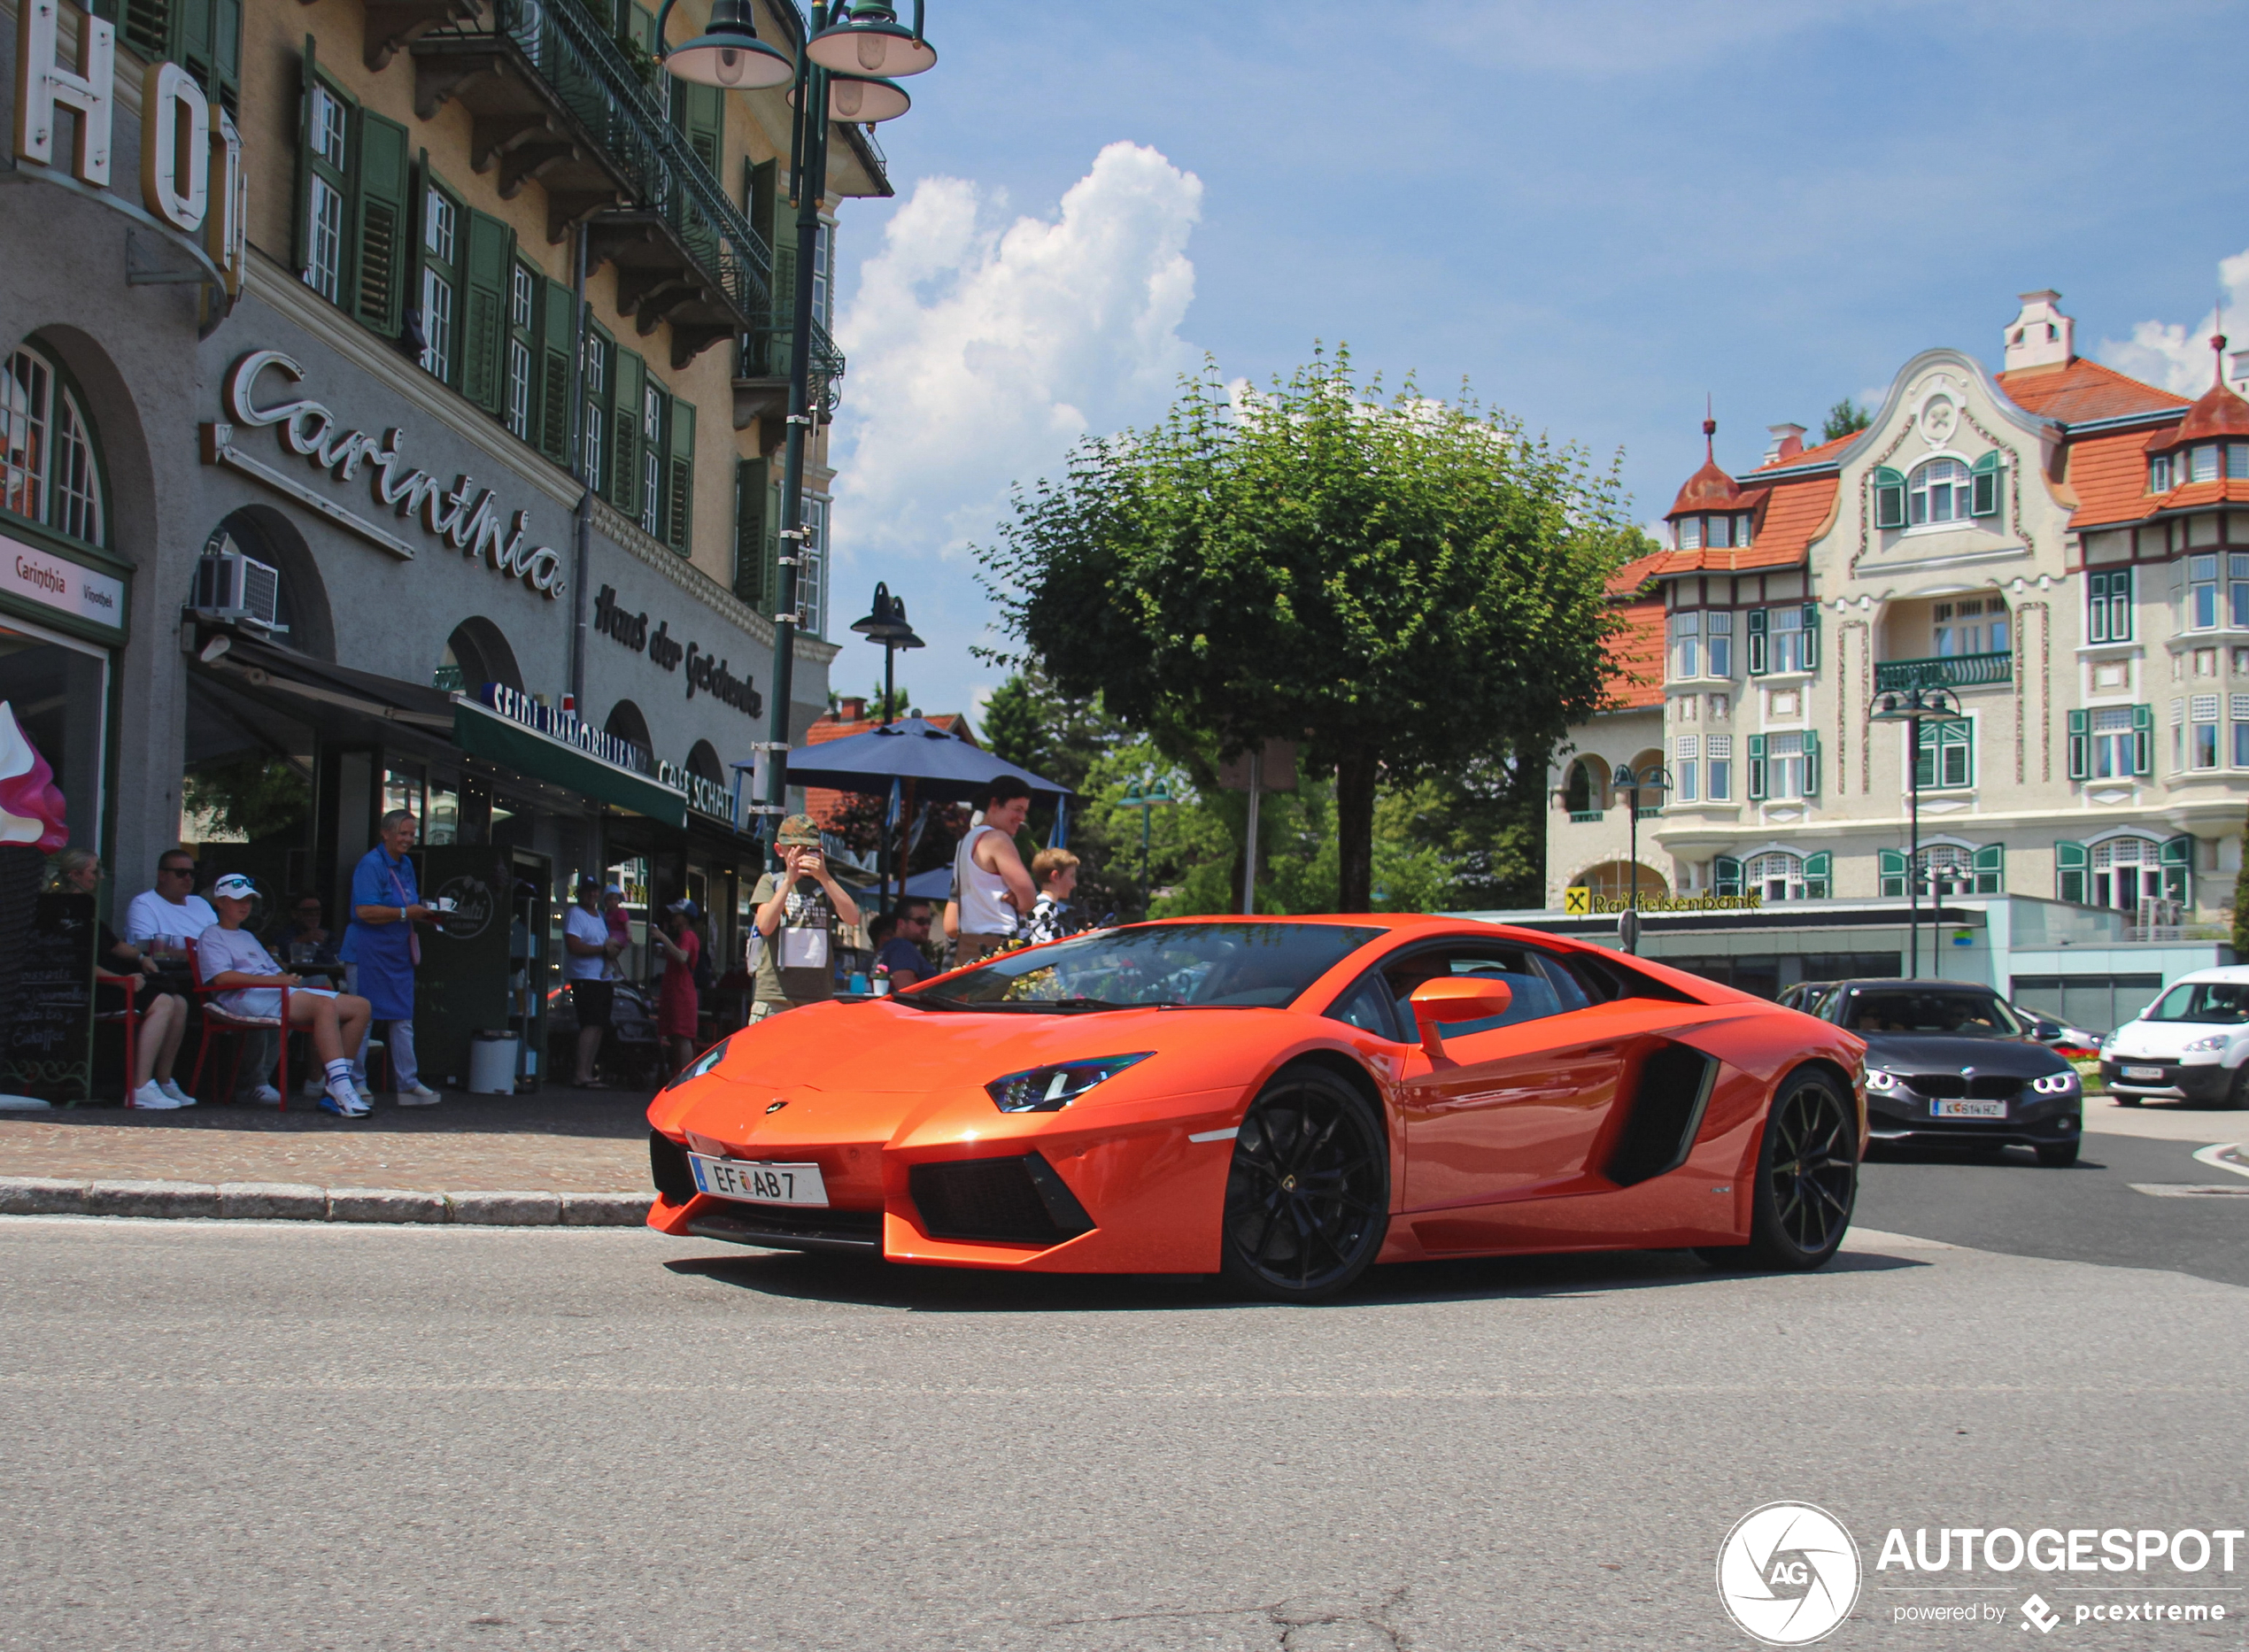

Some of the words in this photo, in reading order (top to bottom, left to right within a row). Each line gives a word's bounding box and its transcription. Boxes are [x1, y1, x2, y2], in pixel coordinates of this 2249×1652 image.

[221, 351, 567, 599] Carinthia
[16, 555, 66, 594] Carinthia
[83, 584, 113, 608] Vinothek
[649, 621, 684, 673] der
[692, 775, 736, 823] SCHAT
[714, 1165, 737, 1193] EF
